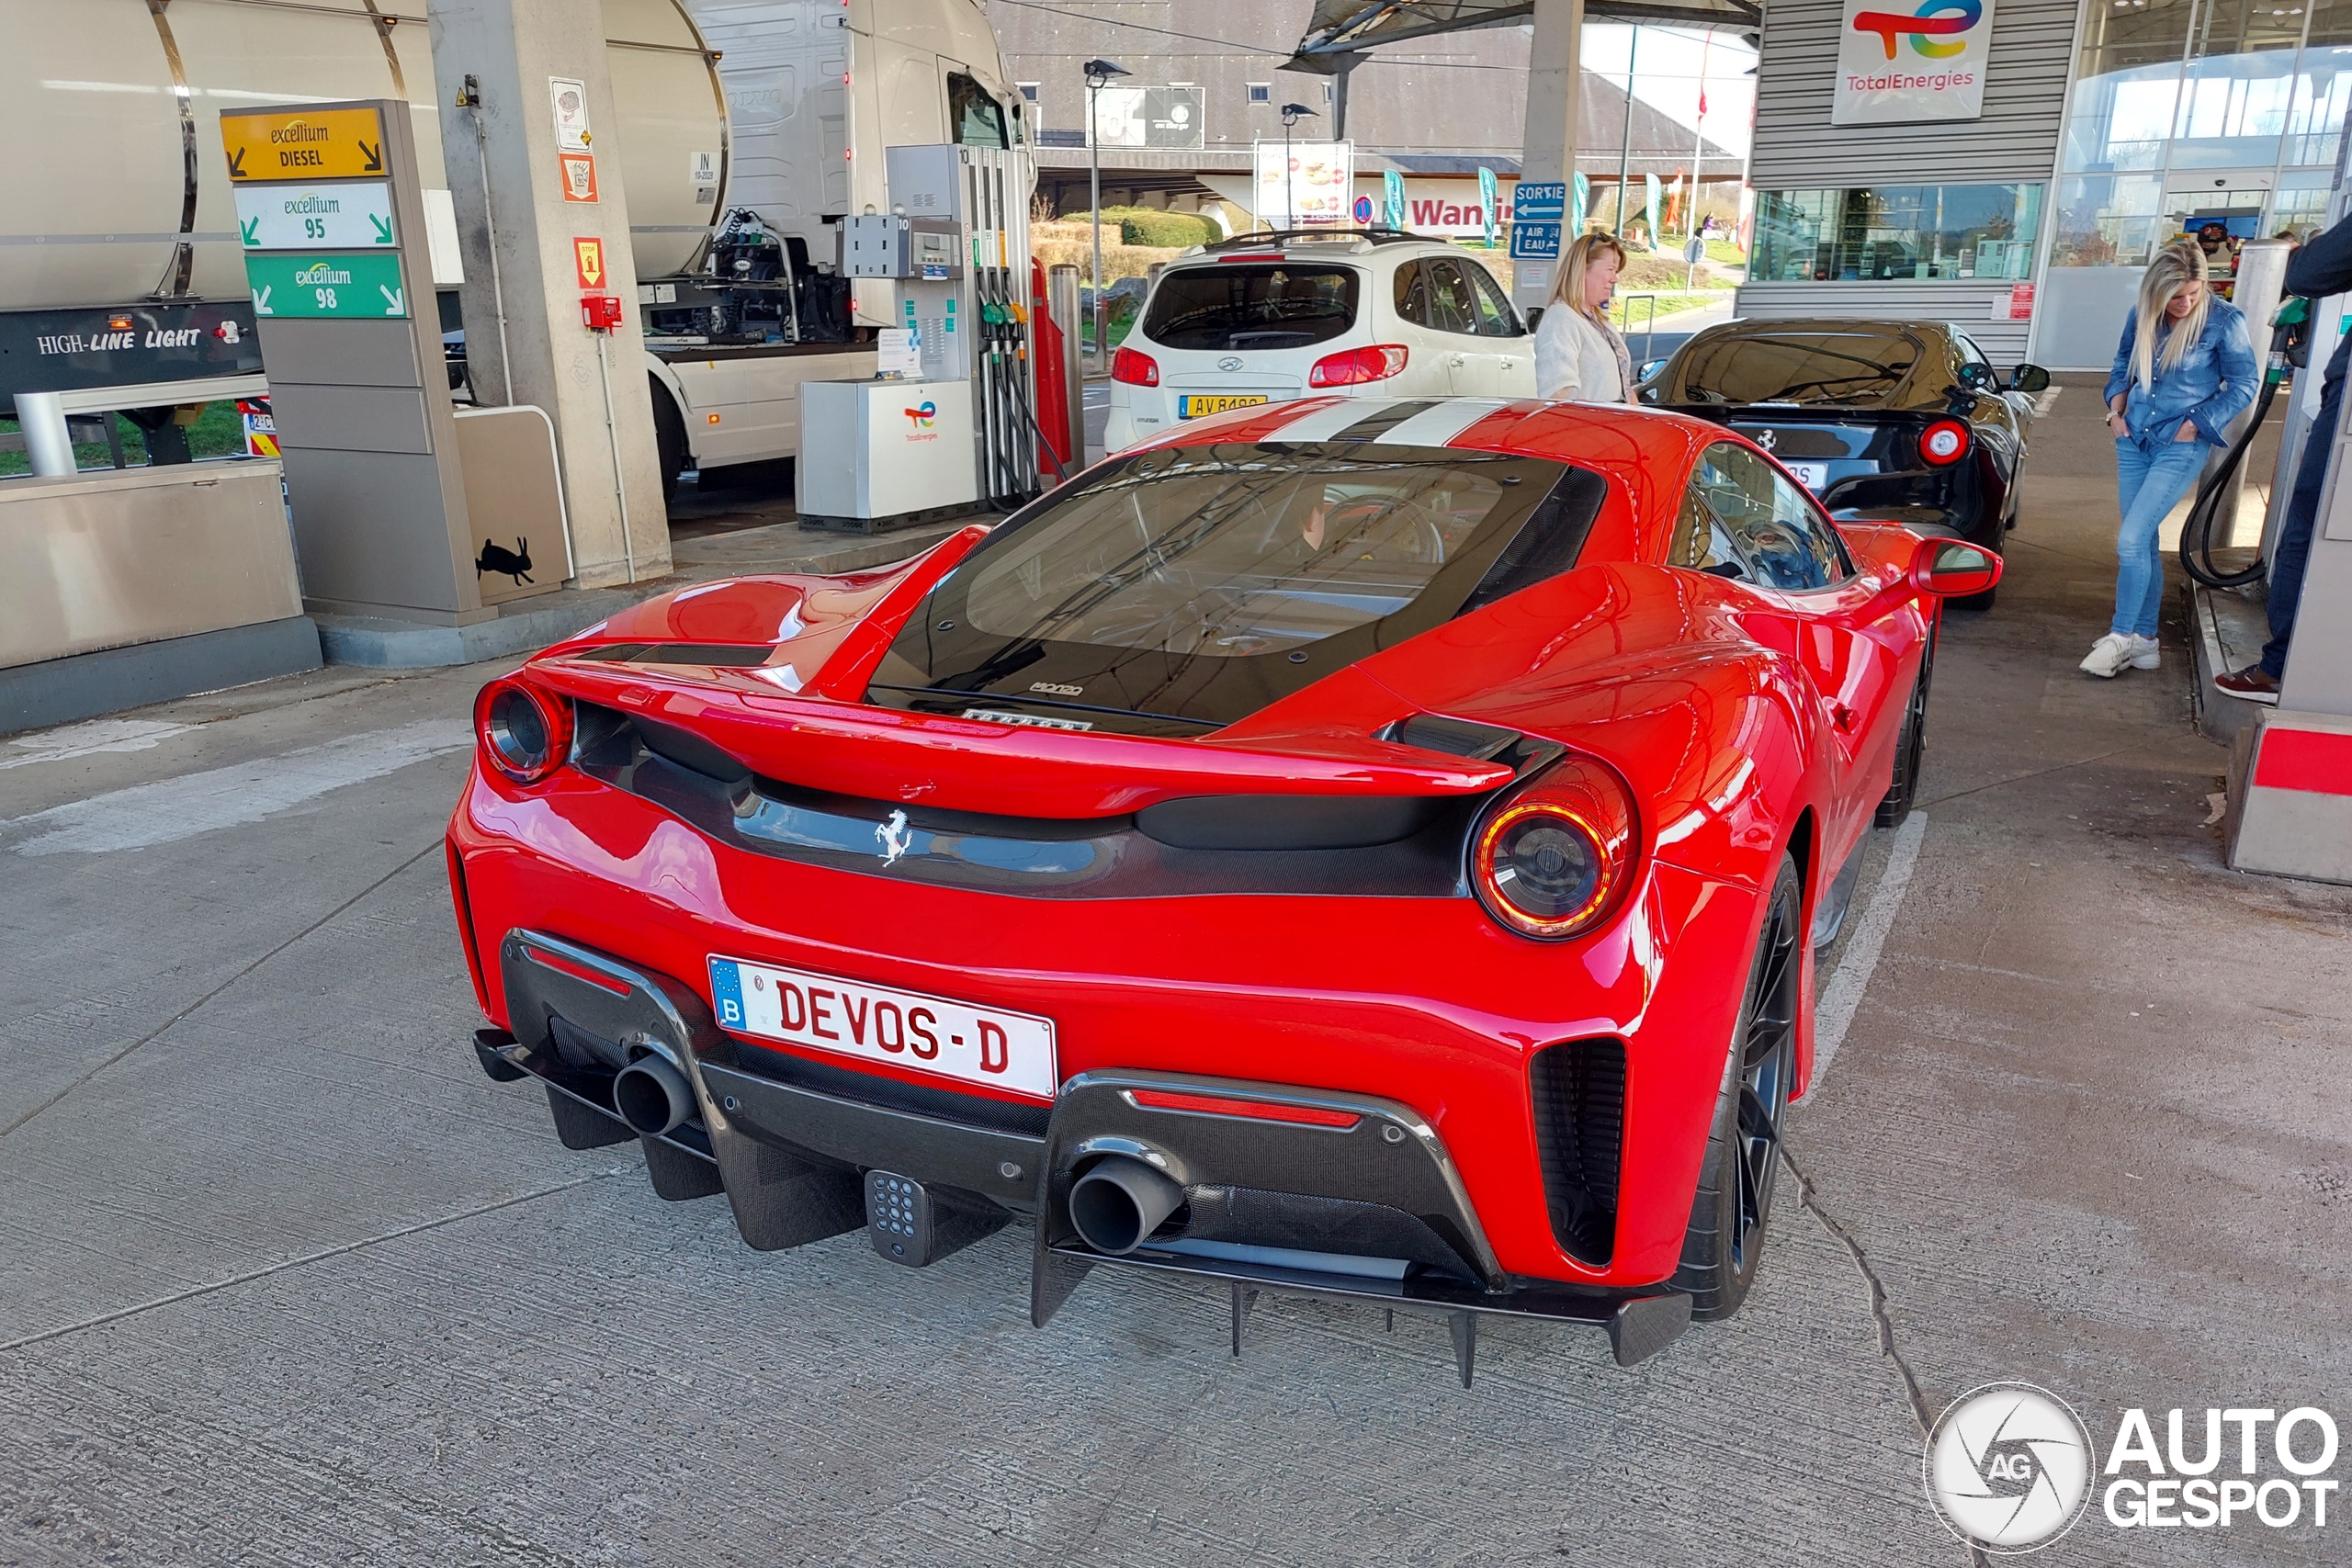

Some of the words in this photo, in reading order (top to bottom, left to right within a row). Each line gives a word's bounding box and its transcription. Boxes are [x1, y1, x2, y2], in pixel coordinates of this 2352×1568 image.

[1847, 70, 1974, 91] TotalEnergies
[726, 89, 783, 107] OLVO
[271, 123, 329, 143] excellium
[279, 149, 323, 167] DIESEL
[700, 152, 710, 171] IN
[958, 149, 969, 164] 10
[1517, 186, 1564, 200] SORTIE
[284, 196, 341, 215] excellium
[305, 218, 325, 239] 95
[836, 221, 843, 231] 11
[898, 219, 910, 231] 10
[1526, 226, 1544, 237] AIR
[1524, 239, 1546, 250] EAU
[295, 266, 352, 285] excellium
[315, 288, 337, 309] 98
[37, 332, 136, 355] HIGH-LINE
[144, 328, 201, 349] LIGHT
[722, 998, 741, 1023] B
